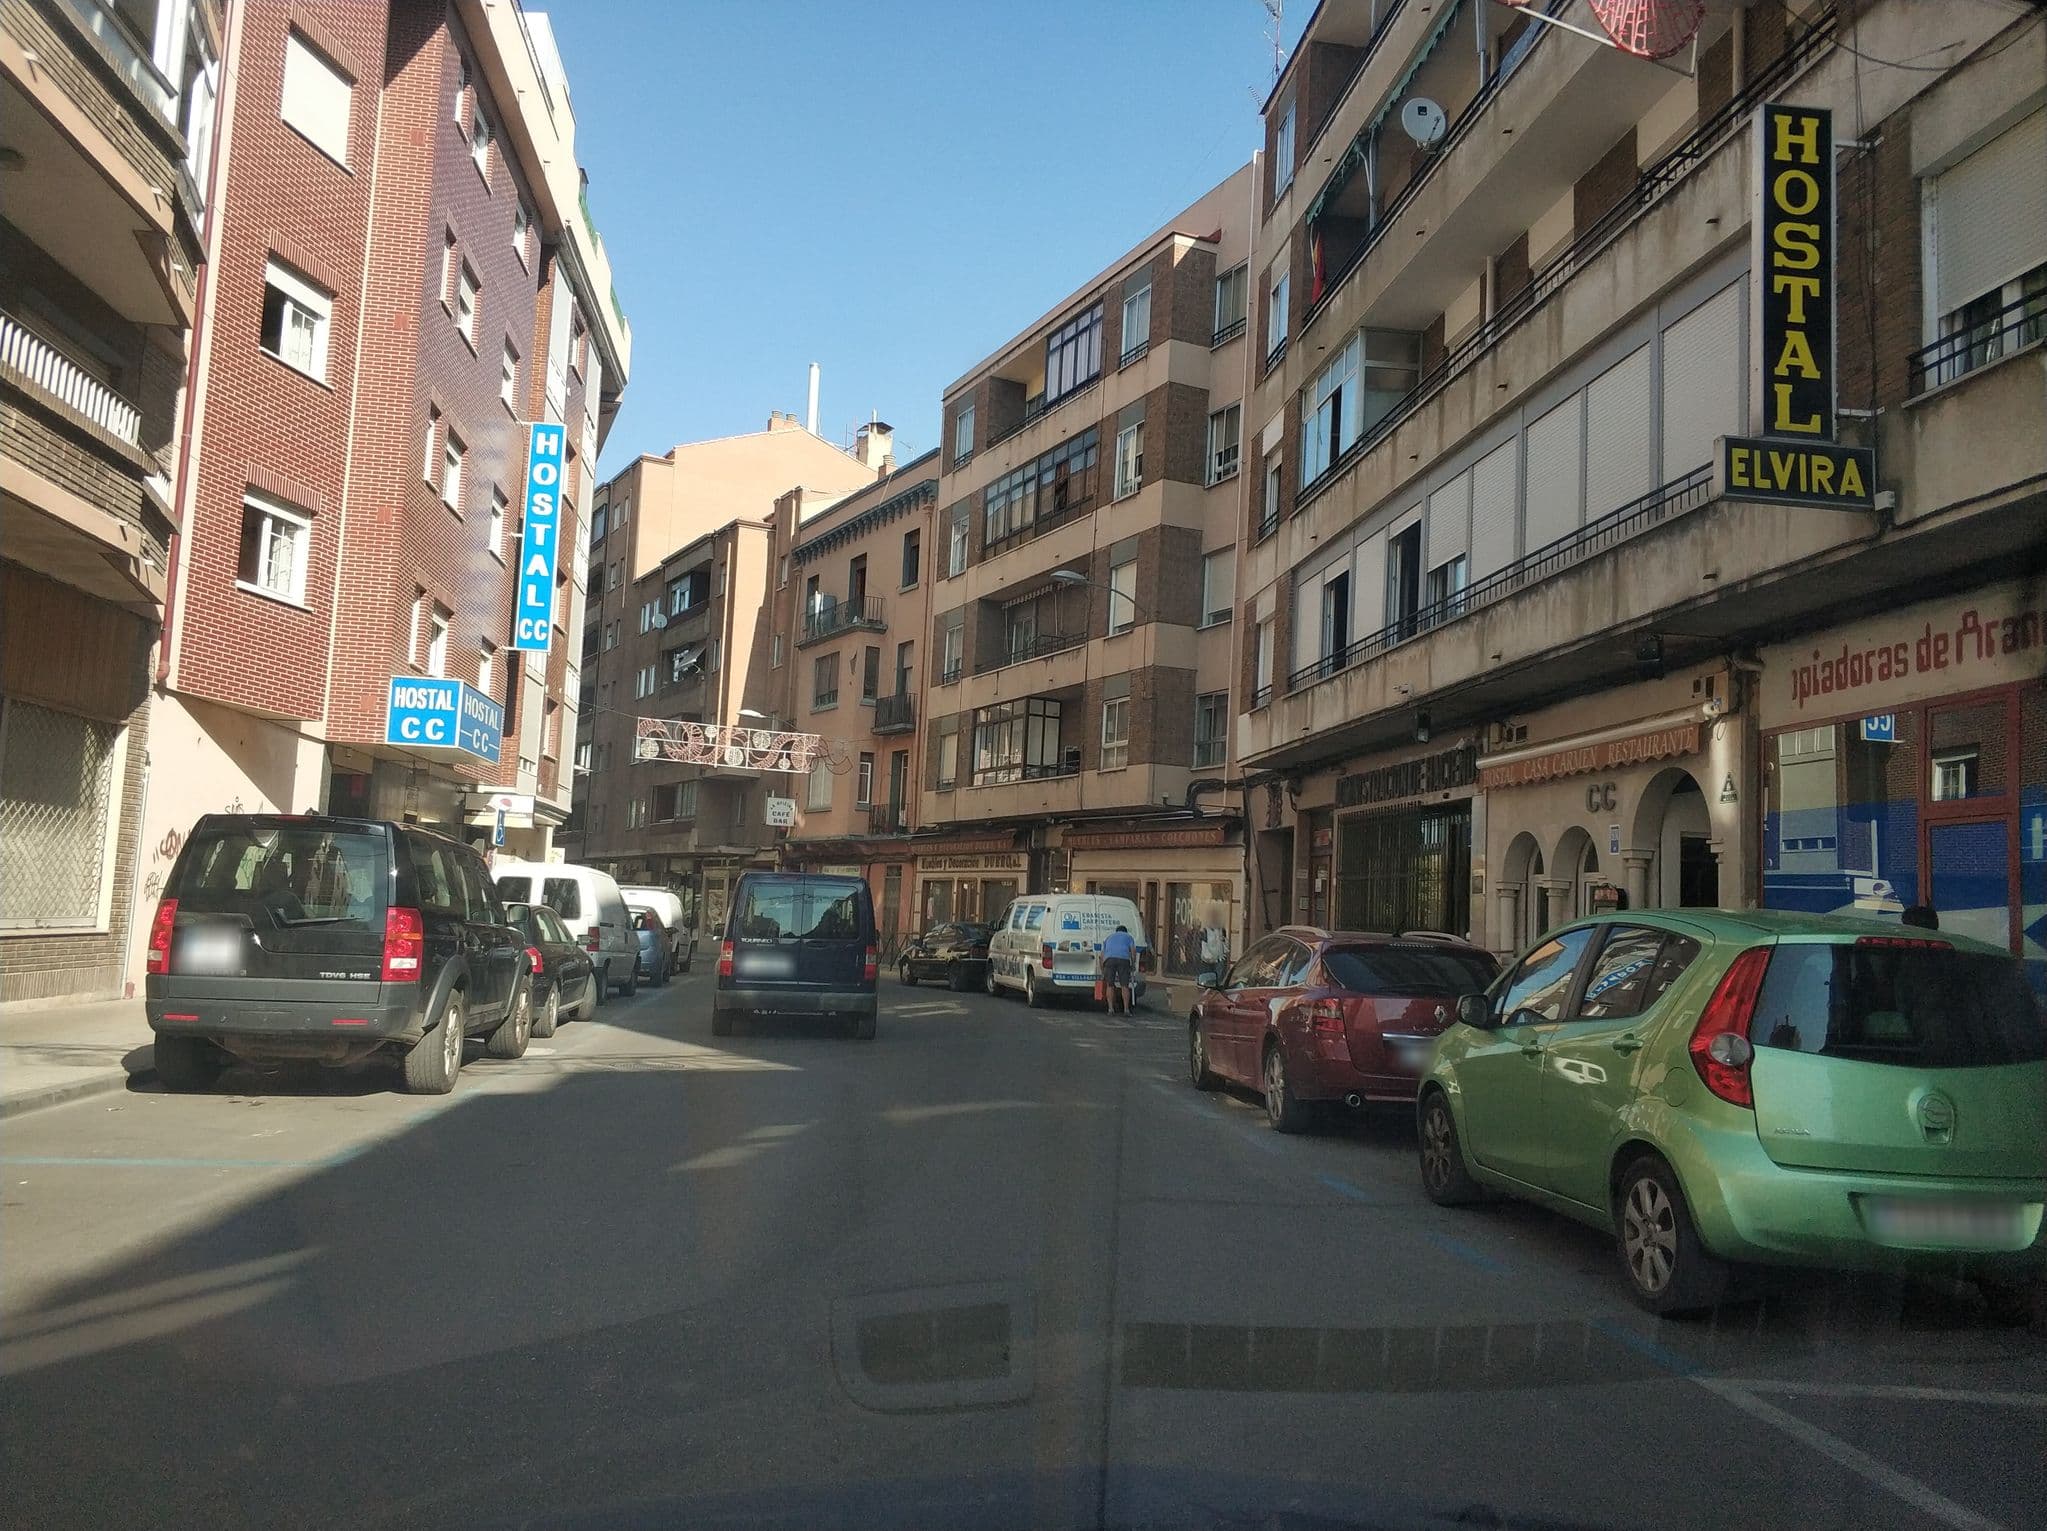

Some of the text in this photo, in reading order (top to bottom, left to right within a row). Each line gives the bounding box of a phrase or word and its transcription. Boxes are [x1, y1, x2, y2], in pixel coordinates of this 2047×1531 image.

[1773, 114, 1821, 435] HOSTAL
[1731, 447, 1866, 498] ELVIRA
[525, 432, 558, 607] HOSTAL
[519, 619, 548, 642] CC
[1916, 623, 1949, 673] de
[394, 686, 456, 711] HOSTAL
[464, 692, 500, 731] HOSTAL
[401, 717, 445, 741] CC
[1484, 727, 1694, 786] HOSTAL CASA CARMEN RESTAURANTE
[1586, 781, 1616, 813] CC
[1161, 831, 1216, 843] COLCHONES
[1082, 918, 1121, 926] CARPINTERO
